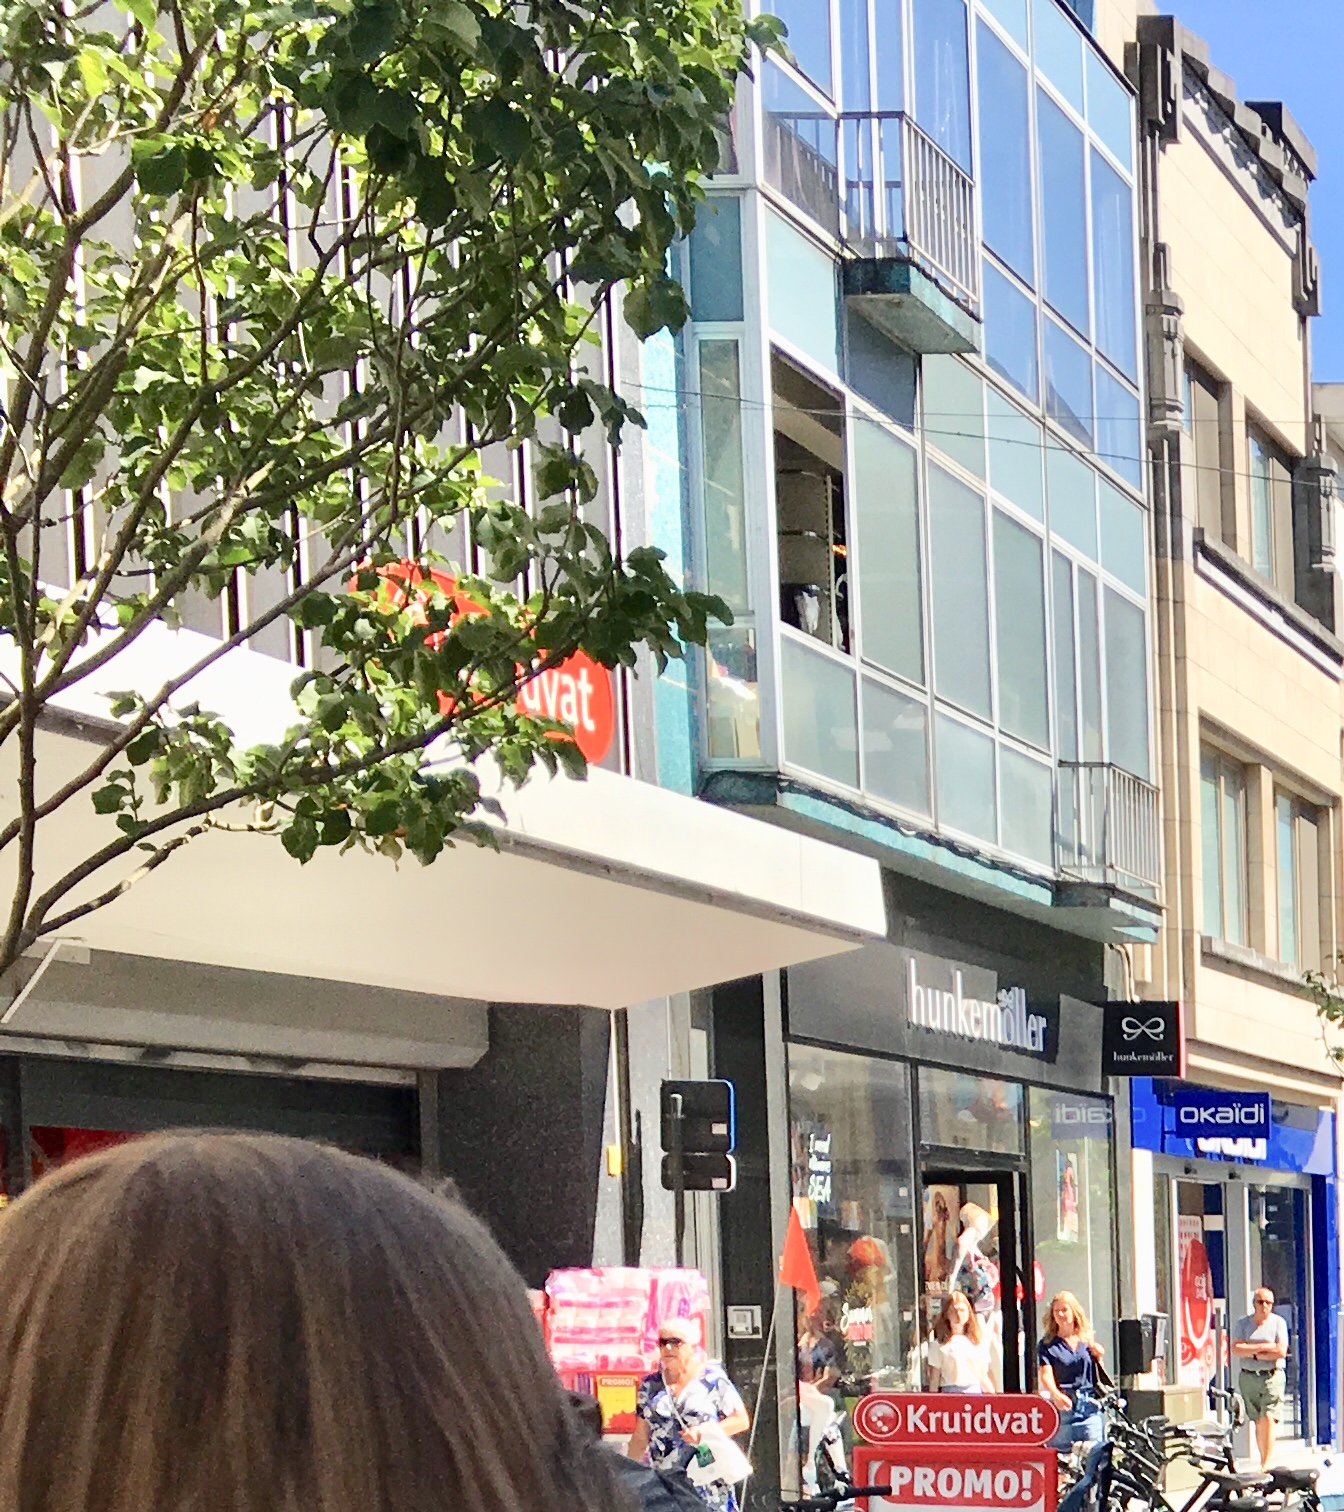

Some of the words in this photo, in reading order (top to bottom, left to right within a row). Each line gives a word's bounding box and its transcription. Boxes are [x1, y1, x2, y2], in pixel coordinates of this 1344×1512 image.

[910, 957, 1047, 1052] hunkemöller
[1179, 1103, 1265, 1124] okaïdi
[601, 1377, 634, 1388] PROMO!
[906, 1403, 1044, 1435] Kruidvat
[890, 1465, 1034, 1501] PROMO!
